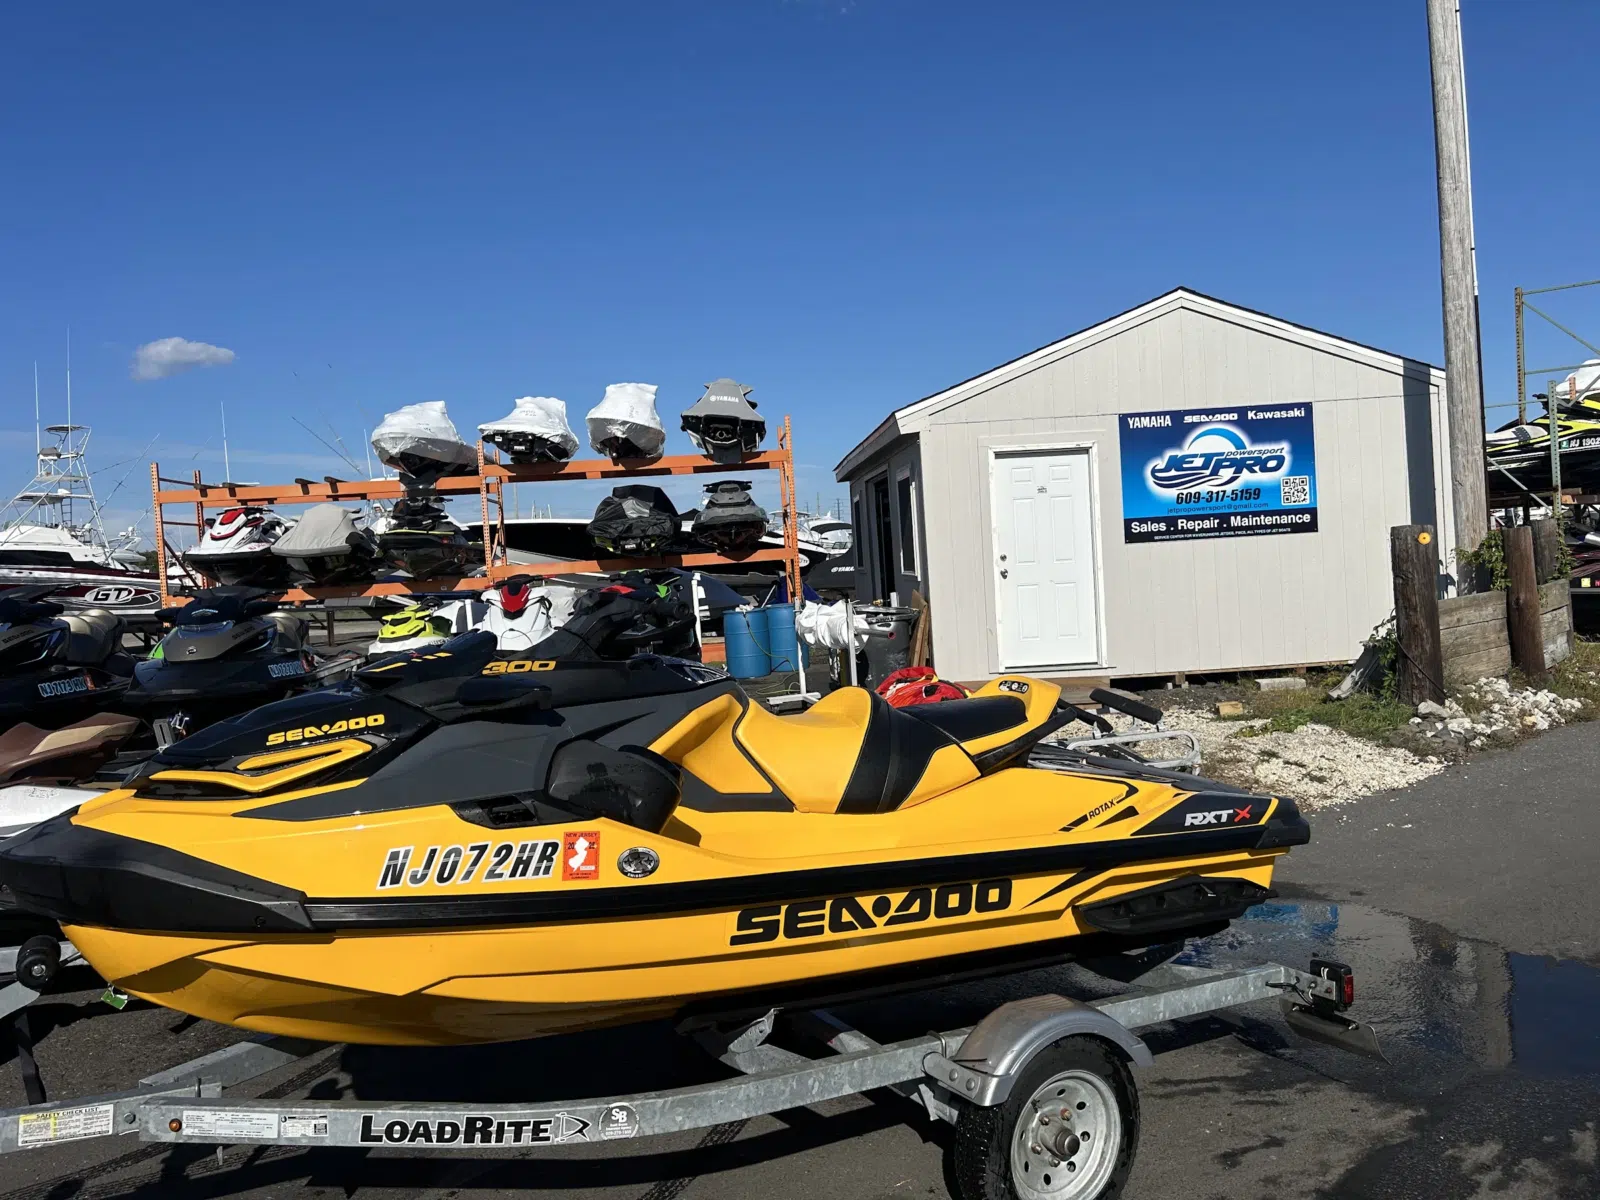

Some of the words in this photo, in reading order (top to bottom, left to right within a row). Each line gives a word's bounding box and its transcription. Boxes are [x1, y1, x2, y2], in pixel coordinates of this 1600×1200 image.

[1128, 415, 1172, 429] YAMAHA
[1248, 408, 1305, 420] Kawasaki
[1225, 447, 1285, 458] powersport
[1176, 488, 1261, 505] 609-317-5159
[1167, 502, 1269, 514] jetpropowersport@gmail.com
[1131, 522, 1167, 533] Sales
[1178, 518, 1220, 532] Repair
[1230, 512, 1311, 528] Maintenance
[93, 588, 128, 602] GT
[482, 661, 556, 675] 300
[1088, 799, 1117, 820] ROTAX
[1184, 809, 1234, 827] RXT
[567, 842, 575, 850] 20
[611, 1108, 627, 1123] SB
[360, 1114, 553, 1145] LOADRITE
